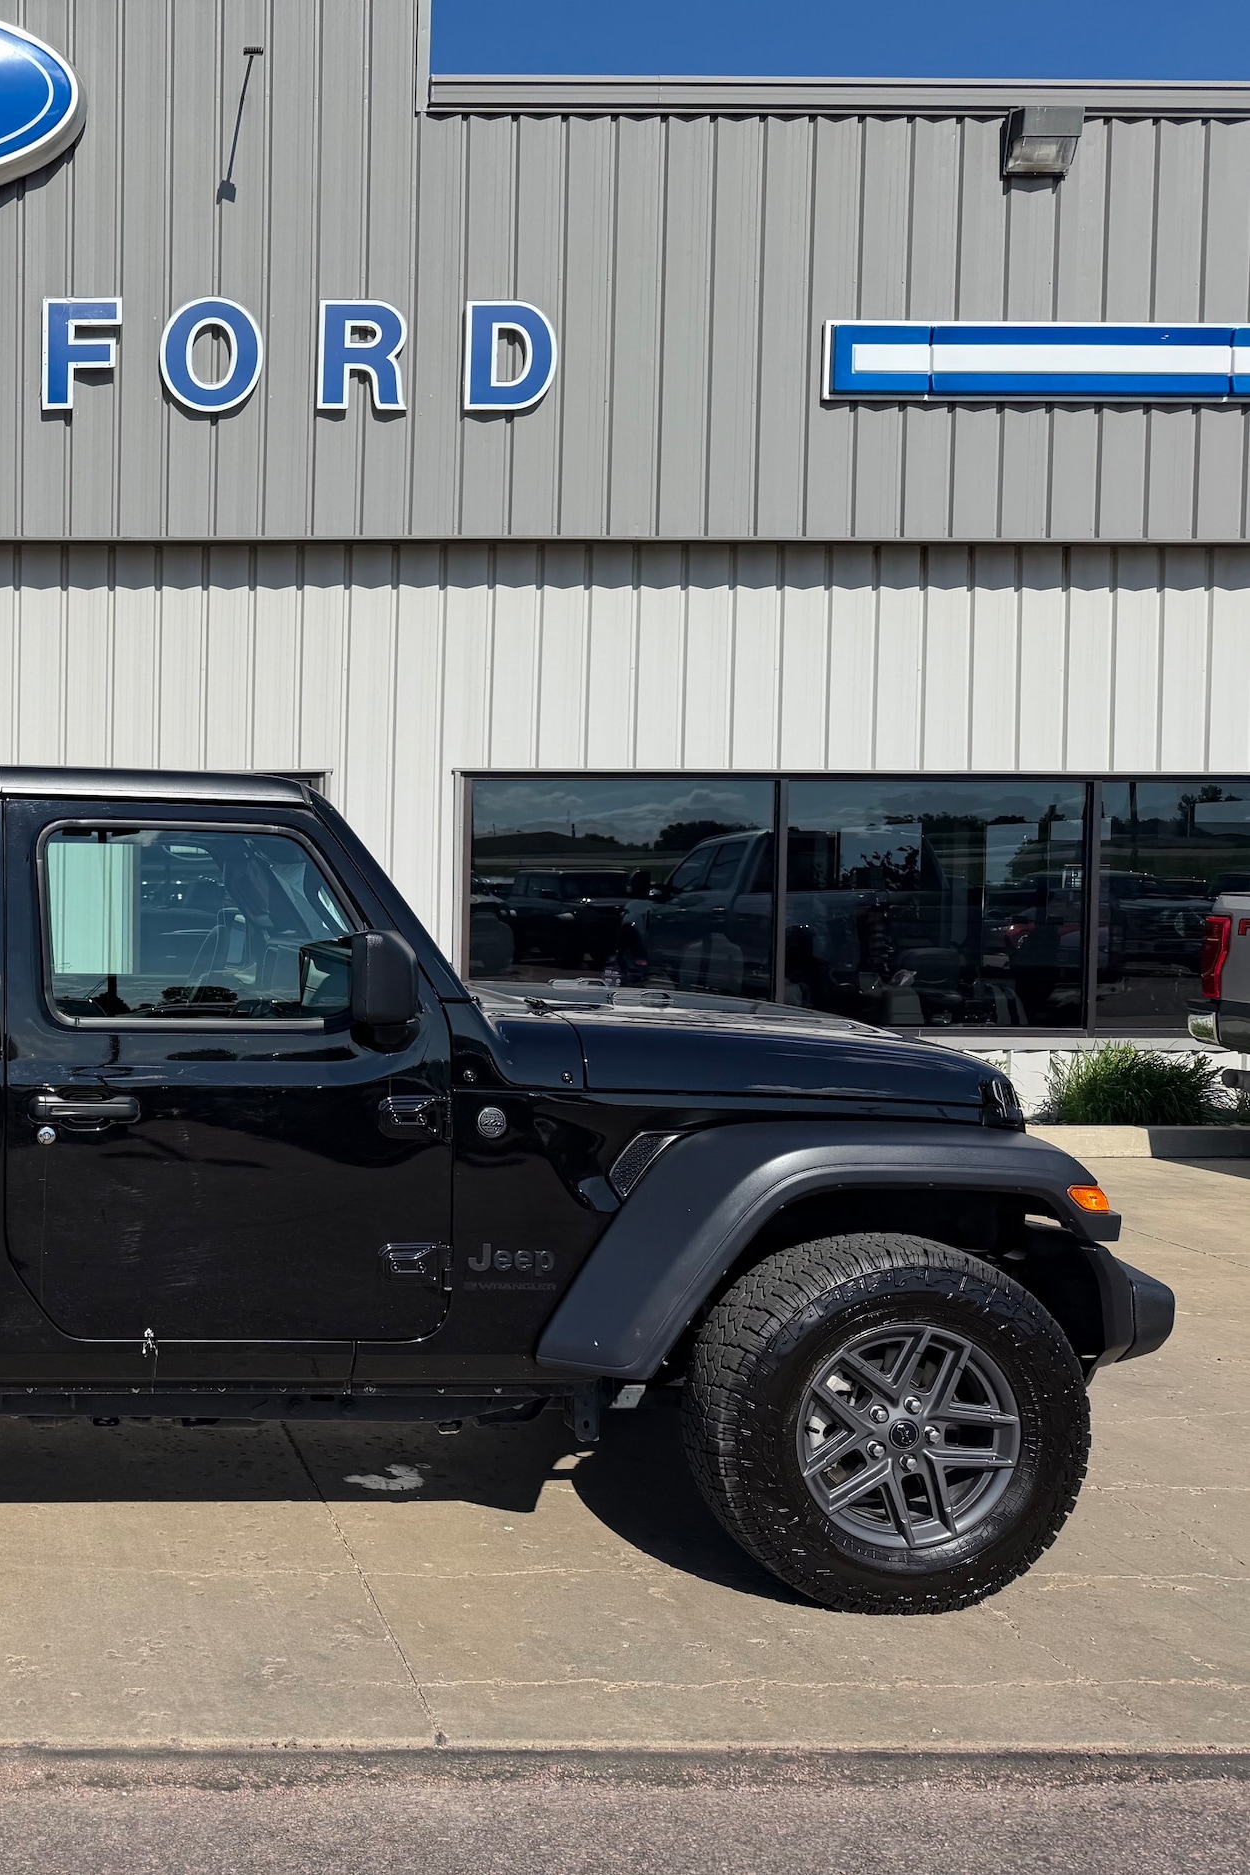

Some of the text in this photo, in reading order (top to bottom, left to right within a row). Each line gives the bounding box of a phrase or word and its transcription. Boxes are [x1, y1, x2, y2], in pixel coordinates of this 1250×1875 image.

[41, 295, 558, 412] FORD
[468, 1243, 555, 1277] Jeep
[478, 1282, 556, 1291] WRANGLER
